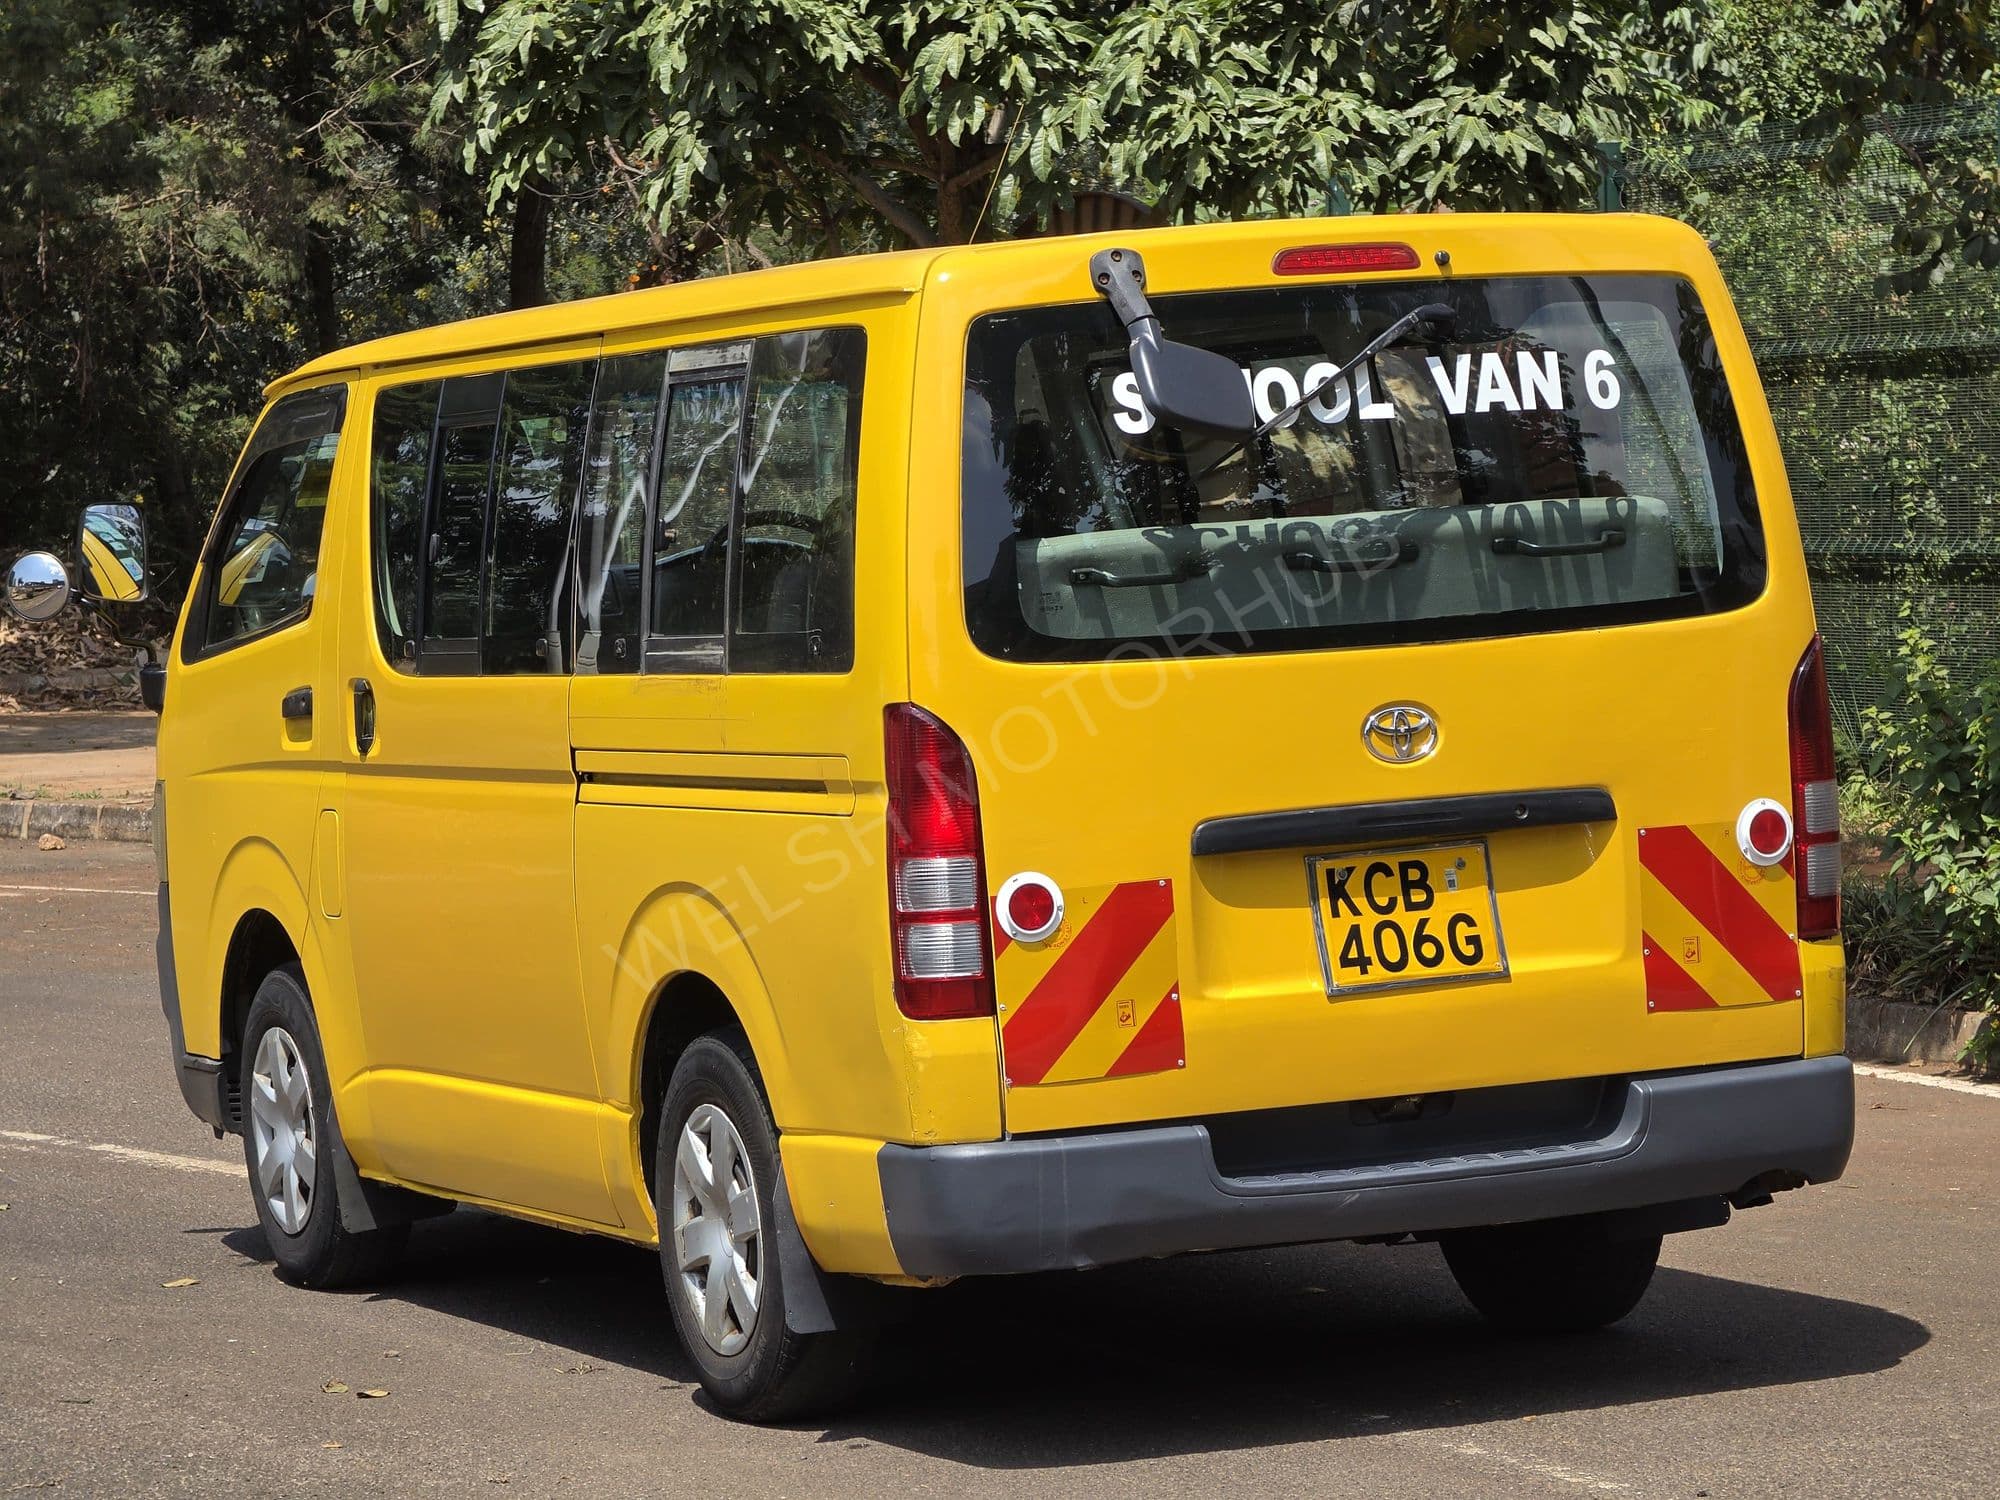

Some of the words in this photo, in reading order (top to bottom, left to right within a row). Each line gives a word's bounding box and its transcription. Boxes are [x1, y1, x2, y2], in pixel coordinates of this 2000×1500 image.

[1112, 354, 1395, 435] SOOL
[1425, 351, 1565, 415] VAN
[1584, 350, 1622, 411] 6
[1326, 860, 1435, 918] KCB
[1339, 913, 1483, 975] 406G
